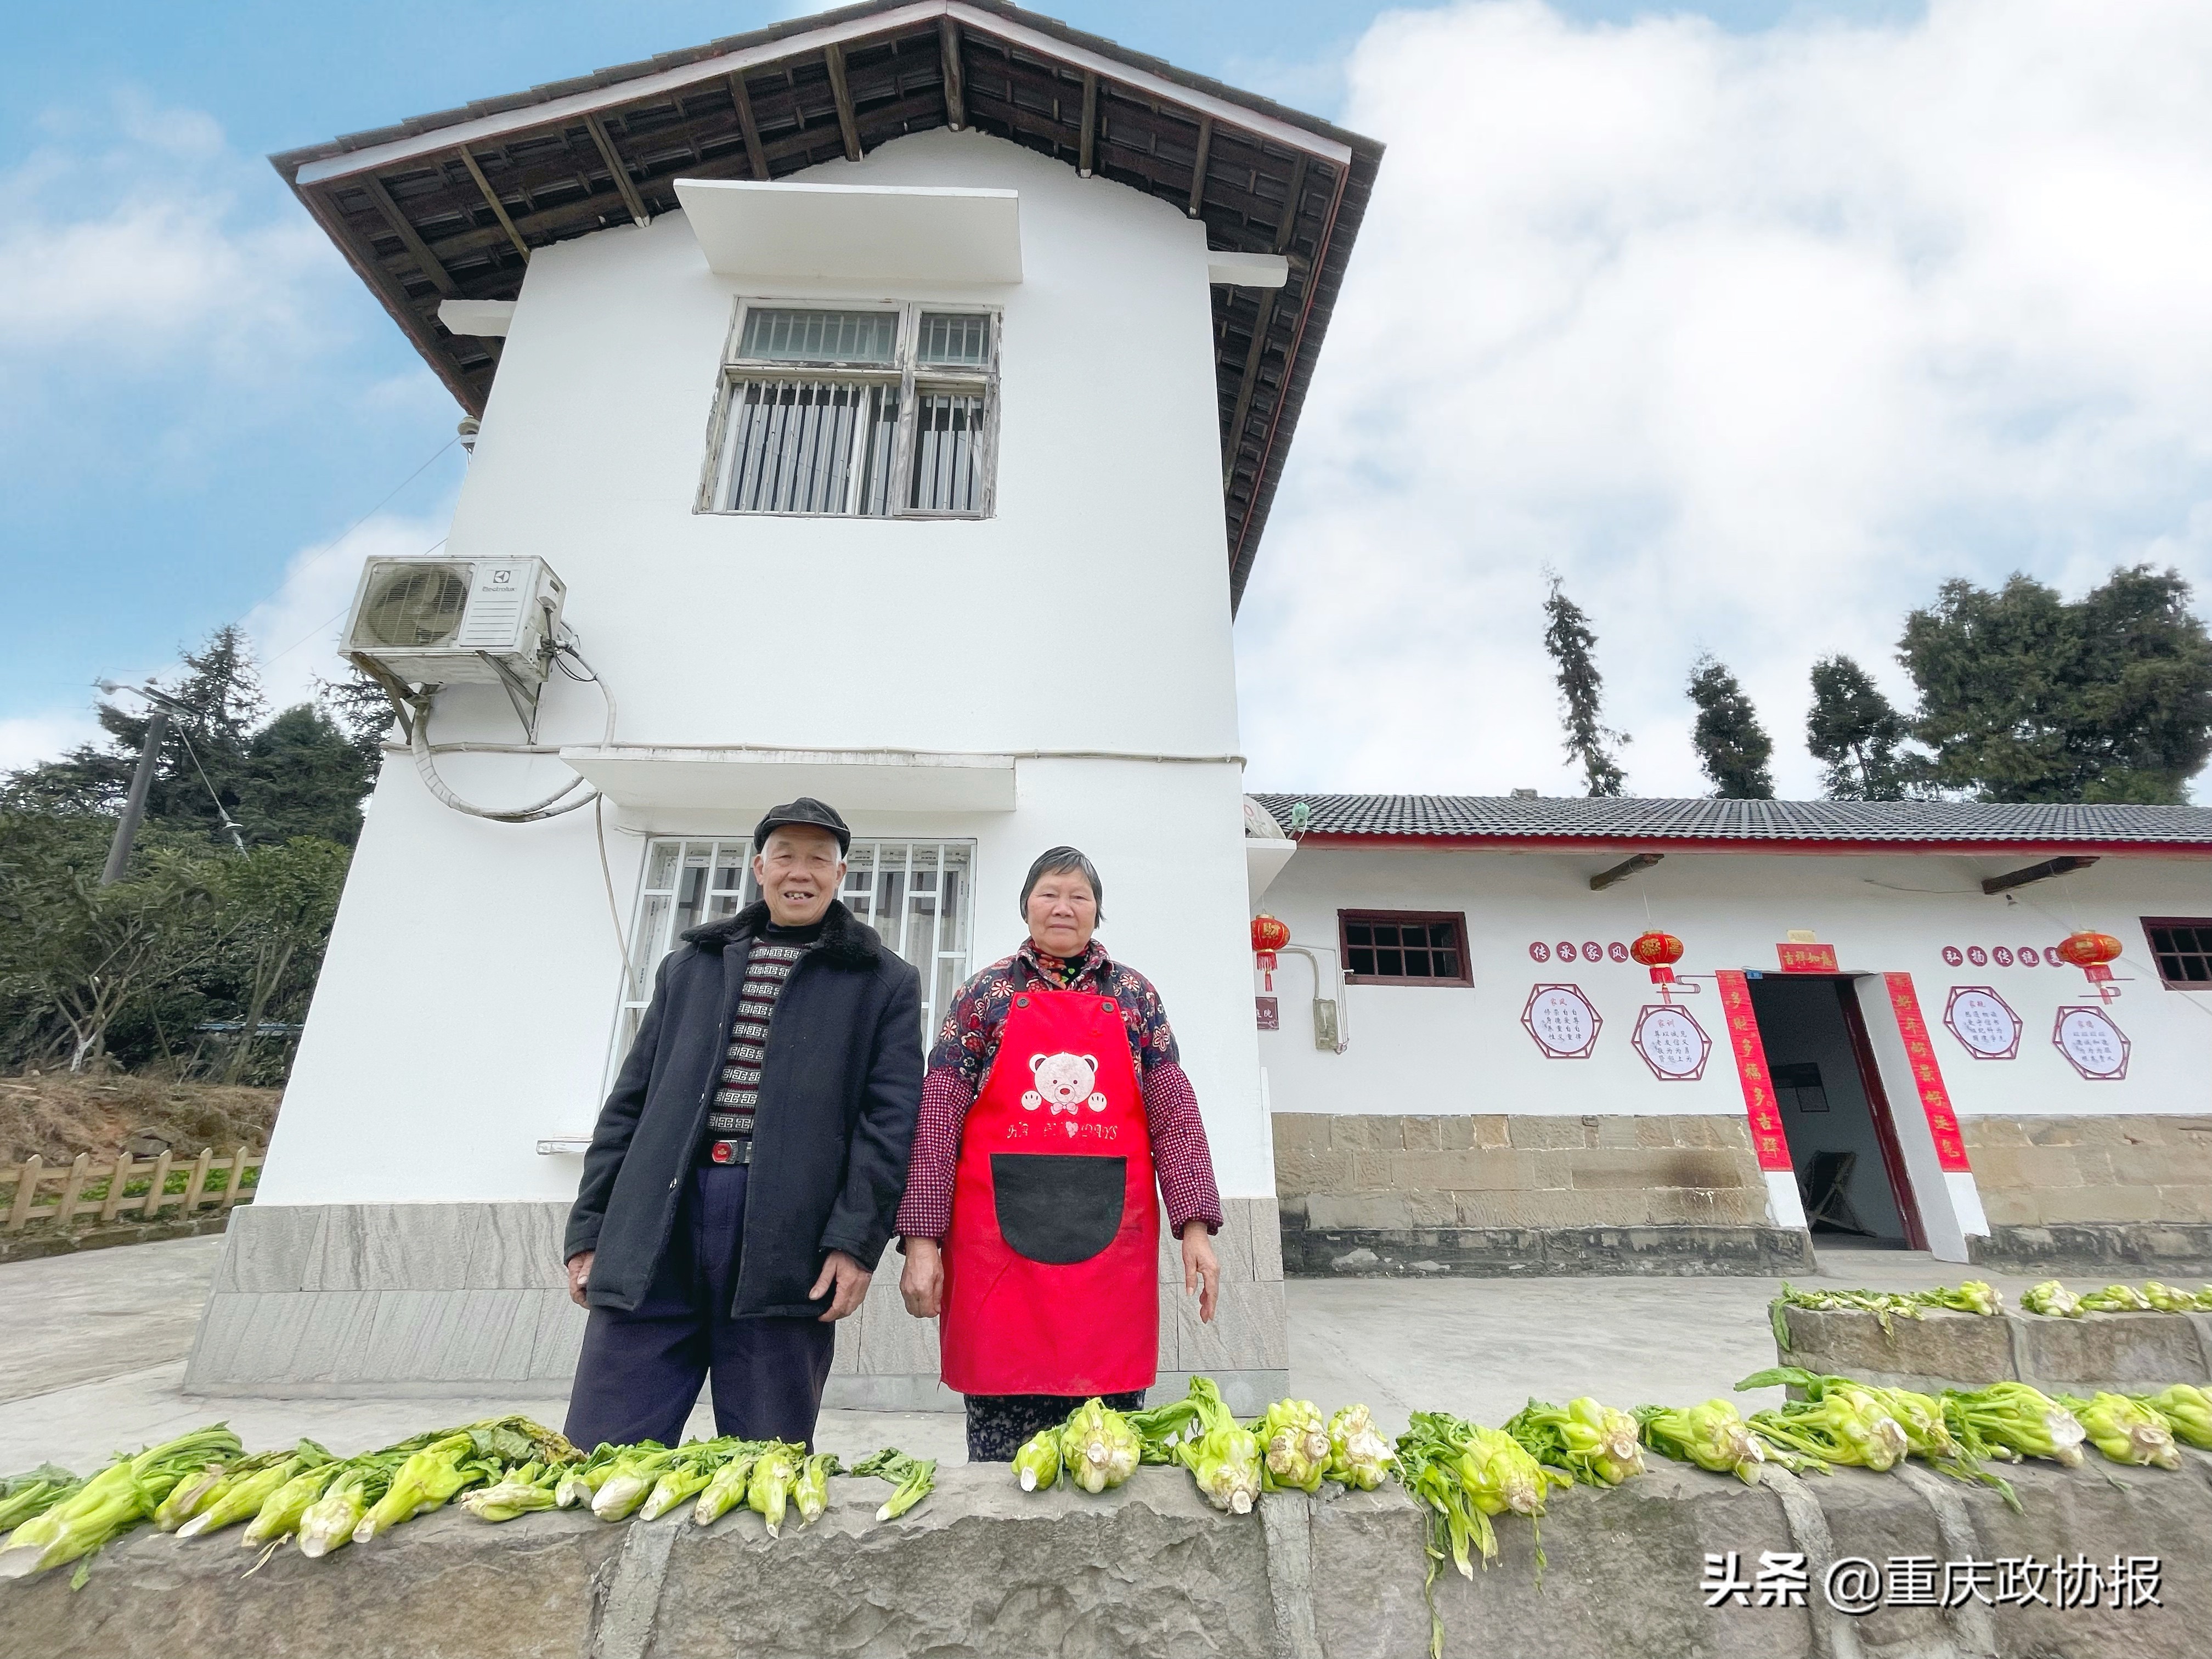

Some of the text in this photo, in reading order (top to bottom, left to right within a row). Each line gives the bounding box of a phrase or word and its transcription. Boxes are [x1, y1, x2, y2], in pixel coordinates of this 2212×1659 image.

[1534, 944, 1626, 960] 传承家风
[1784, 951, 1833, 966] 吉祥如意
[1896, 994, 1961, 1158] 好年好景好运气
